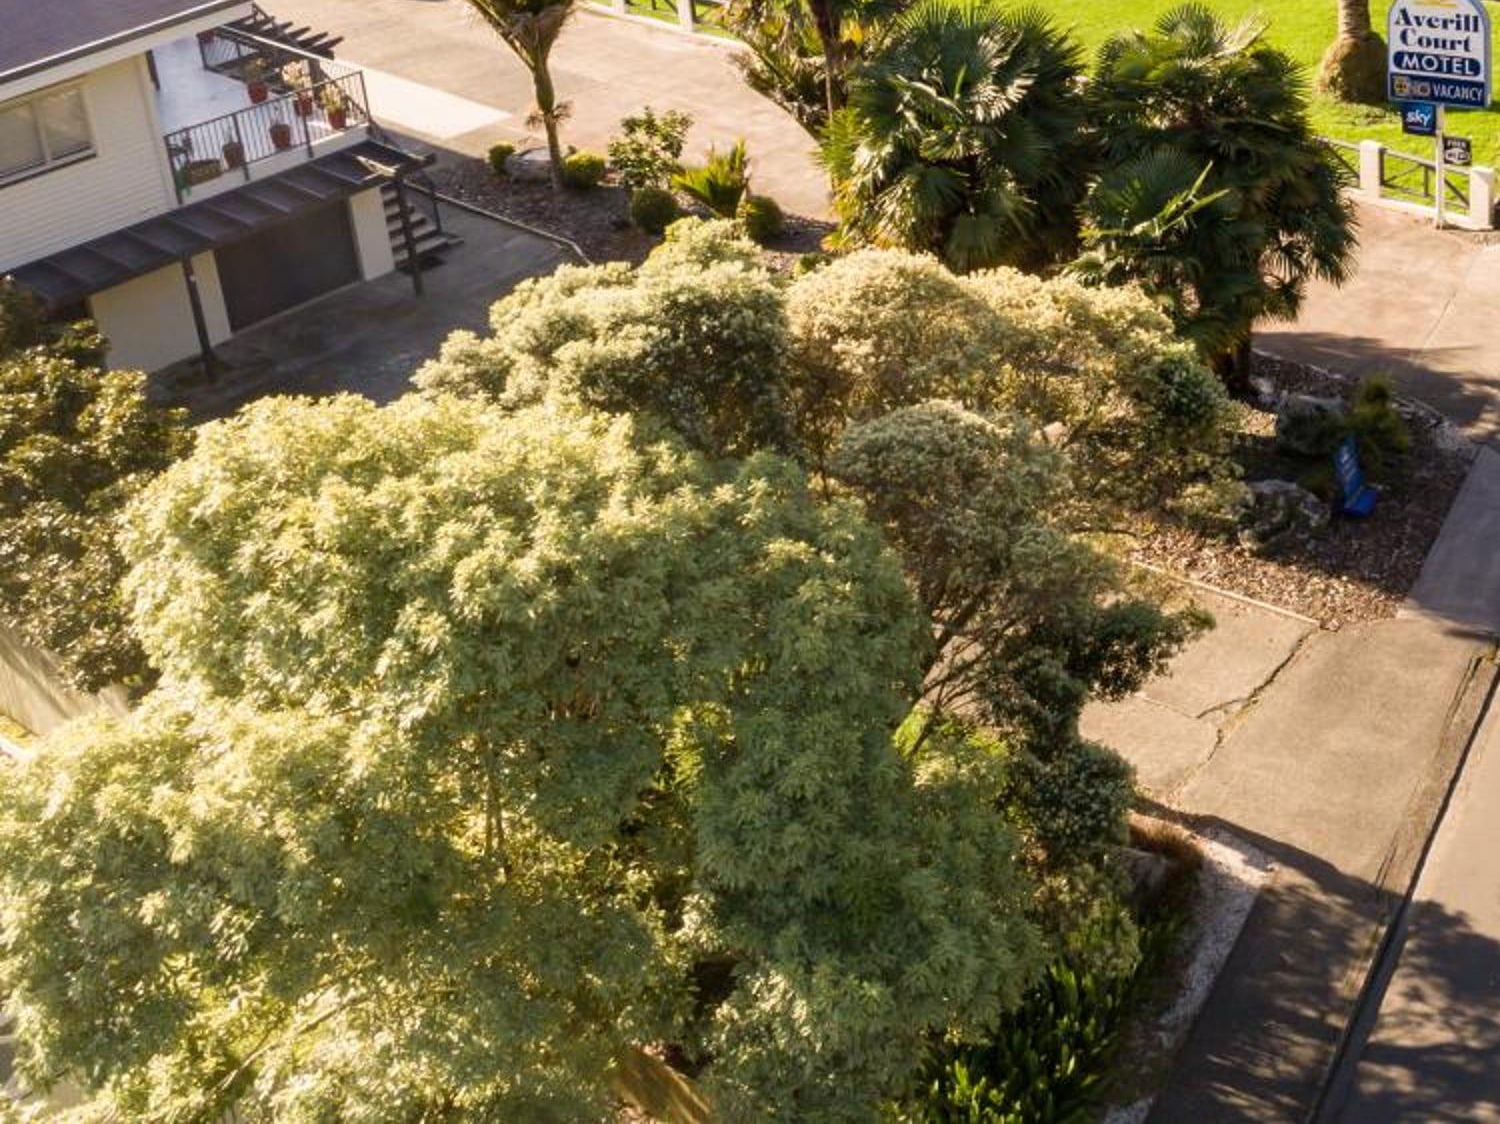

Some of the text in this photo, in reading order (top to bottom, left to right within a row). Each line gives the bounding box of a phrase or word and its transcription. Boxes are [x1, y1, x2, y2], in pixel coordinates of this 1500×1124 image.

[1395, 8, 1480, 33] Averill
[1399, 28, 1472, 53] Court
[1401, 54, 1475, 76] MOTEL
[1433, 82, 1483, 102] VACANCY
[1406, 109, 1432, 127] sky
